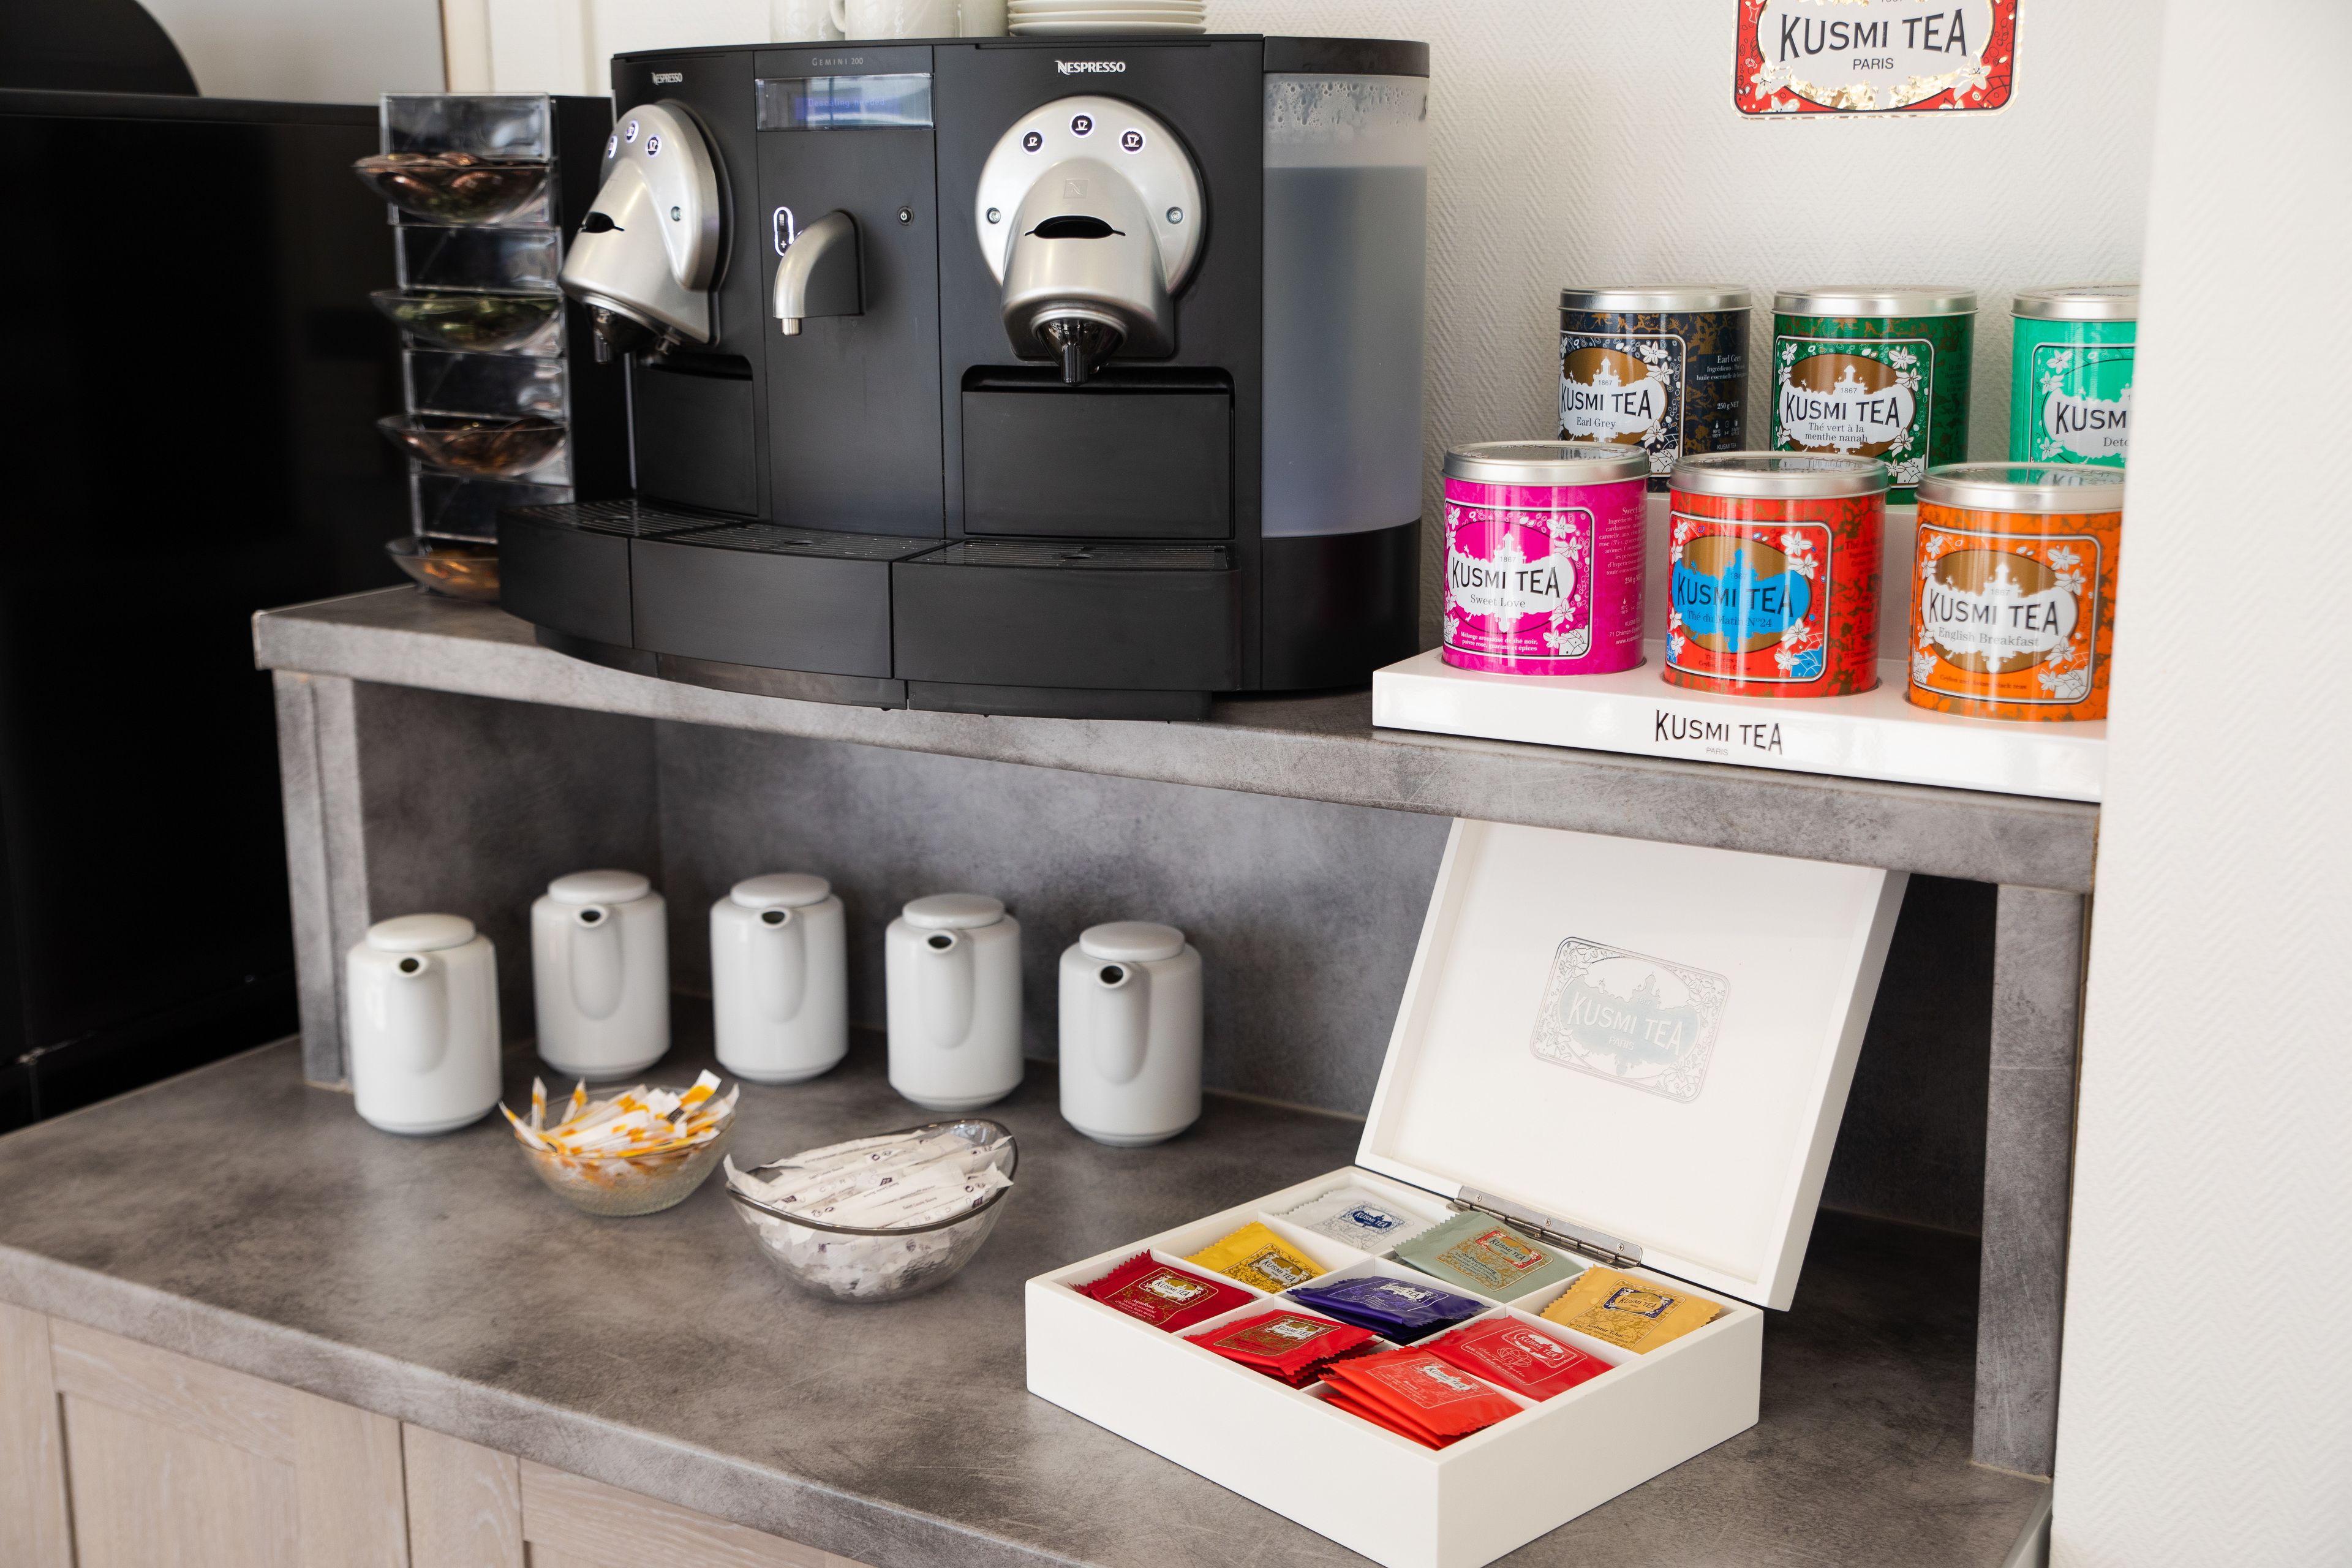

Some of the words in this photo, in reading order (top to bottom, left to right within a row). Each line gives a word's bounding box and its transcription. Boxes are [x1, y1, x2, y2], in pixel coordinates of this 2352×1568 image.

[1779, 13, 1888, 62] KUSMI
[1902, 9, 1967, 56] TEA
[1054, 60, 1126, 75] NESPRESSO
[1852, 58, 1894, 70] PARIS
[650, 72, 683, 85] NESPRESSO
[809, 98, 850, 108] Descaling
[1717, 355, 1730, 363] Earl
[1561, 384, 1604, 413] KUSMI
[1611, 390, 1652, 419] TEA
[1785, 392, 1847, 423] KUSMI
[1855, 396, 1901, 428] TEA
[1577, 417, 1591, 426] Earl
[1594, 419, 1616, 429] Grey
[2056, 402, 2127, 435] KUSM
[1809, 423, 1824, 431] Thé
[1826, 424, 1844, 432] vert
[1847, 424, 1853, 432] à
[1805, 432, 1836, 442] menthe
[1622, 507, 1638, 515] Sweet
[1452, 557, 1506, 589] KUSMI
[1517, 567, 1561, 598] TEA
[1470, 594, 1498, 606] Sweet
[1500, 597, 1525, 608] Love
[1677, 573, 1736, 608] KUSMI
[1748, 585, 1793, 617] TEA
[1687, 610, 1700, 620] Thé
[1703, 613, 1714, 622] du
[1717, 615, 1743, 626] Matin
[1929, 588, 1997, 625] KUSMI
[2009, 601, 2059, 636] TEA
[1460, 631, 1477, 641] Mélange
[1939, 627, 1975, 644] English
[1979, 633, 2039, 647] Breakfast
[1655, 709, 1730, 742] KUSMI
[1739, 723, 1783, 756] TEA
[1706, 747, 1728, 756] PARIS
[1567, 992, 1638, 1035] KUSMI
[1645, 1017, 1683, 1056] TEA
[1608, 1036, 1635, 1051] PARIS
[1354, 1212, 1376, 1223] KUSMI
[1375, 1219, 1389, 1228] TEA
[1490, 1238, 1512, 1253] KUSMI
[1512, 1251, 1526, 1261] TEA
[1262, 1260, 1283, 1275] KUSMI
[1283, 1273, 1296, 1283] TEA
[1155, 1281, 1177, 1292] KUSMI
[1132, 1298, 1155, 1310] AquaRosa
[1587, 1324, 1608, 1333] Kashmir
[1518, 1335, 1544, 1349] KUSMI
[1543, 1349, 1558, 1358] TEA
[1427, 1367, 1451, 1380] KUSMI
